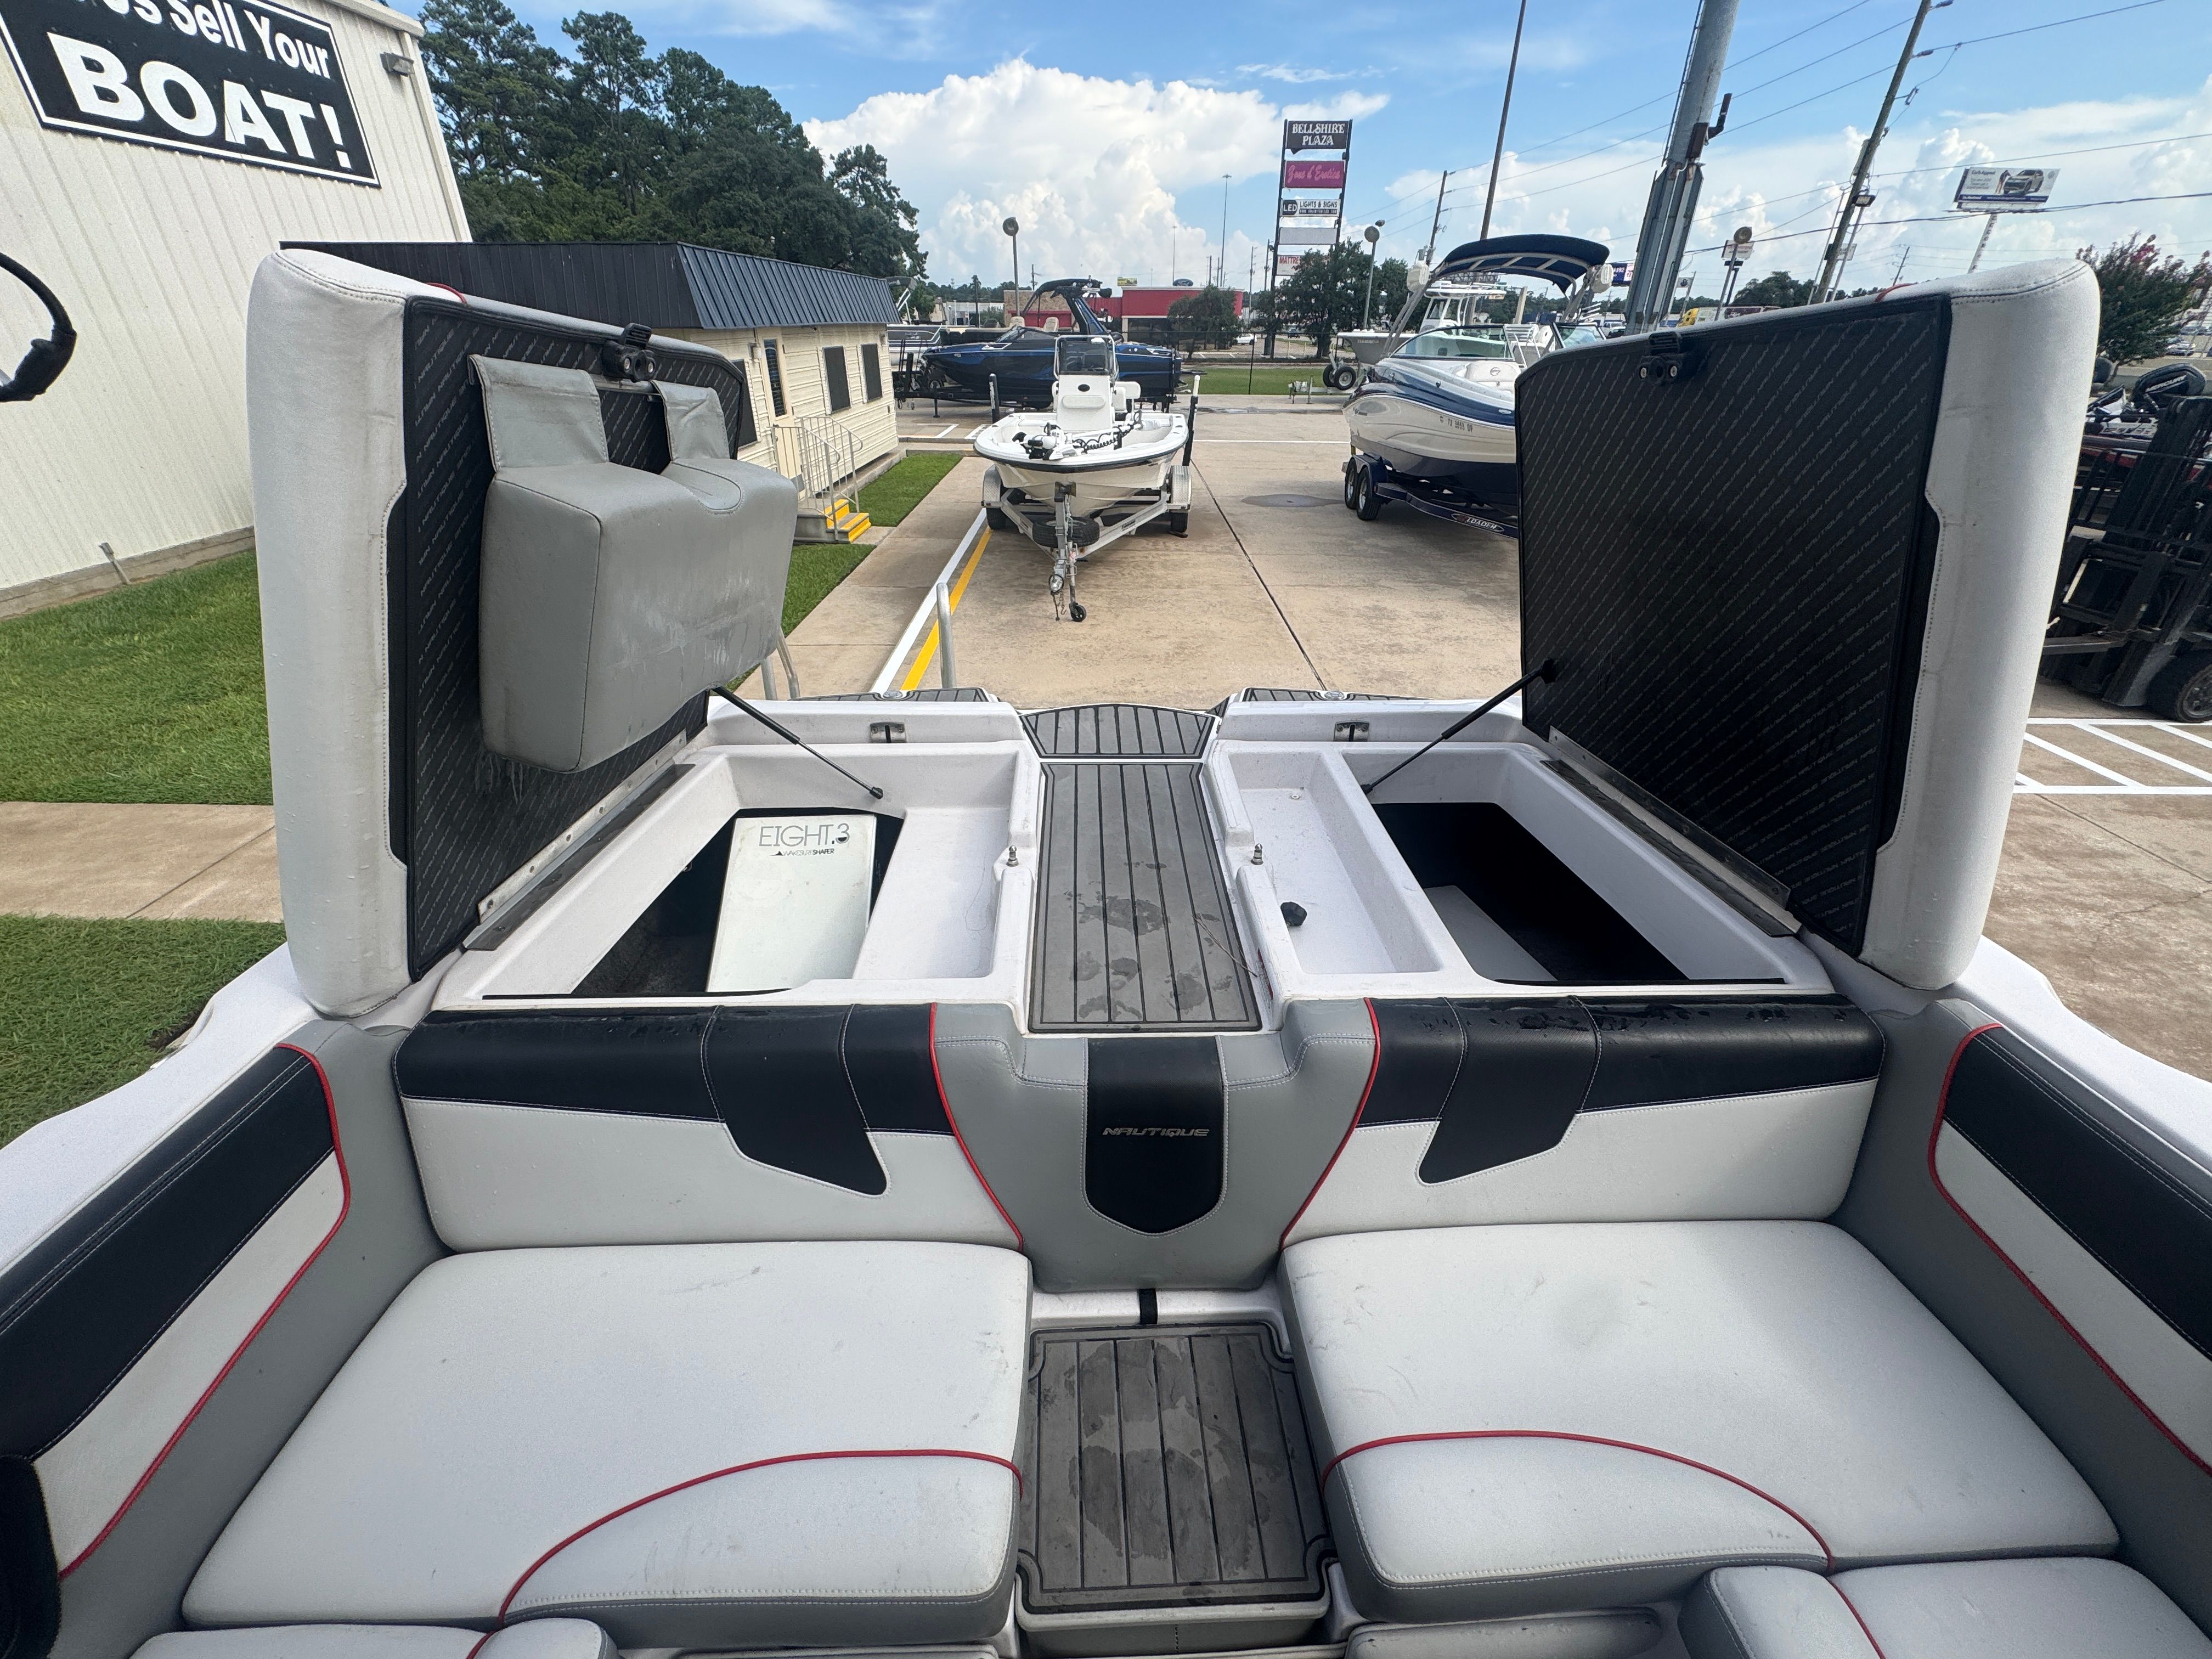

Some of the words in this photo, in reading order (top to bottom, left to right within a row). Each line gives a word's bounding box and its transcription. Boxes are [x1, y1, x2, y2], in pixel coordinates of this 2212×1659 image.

[170, 0, 247, 52] Sell
[244, 9, 330, 79] Your
[47, 32, 353, 170] BOAT!
[1292, 123, 1346, 134] BELLSHIRE
[1302, 134, 1334, 146] PLAZA
[1283, 204, 1297, 212] LED
[759, 823, 850, 847] EIGHT.3
[1102, 1127, 1210, 1137] NAUTIQUE
